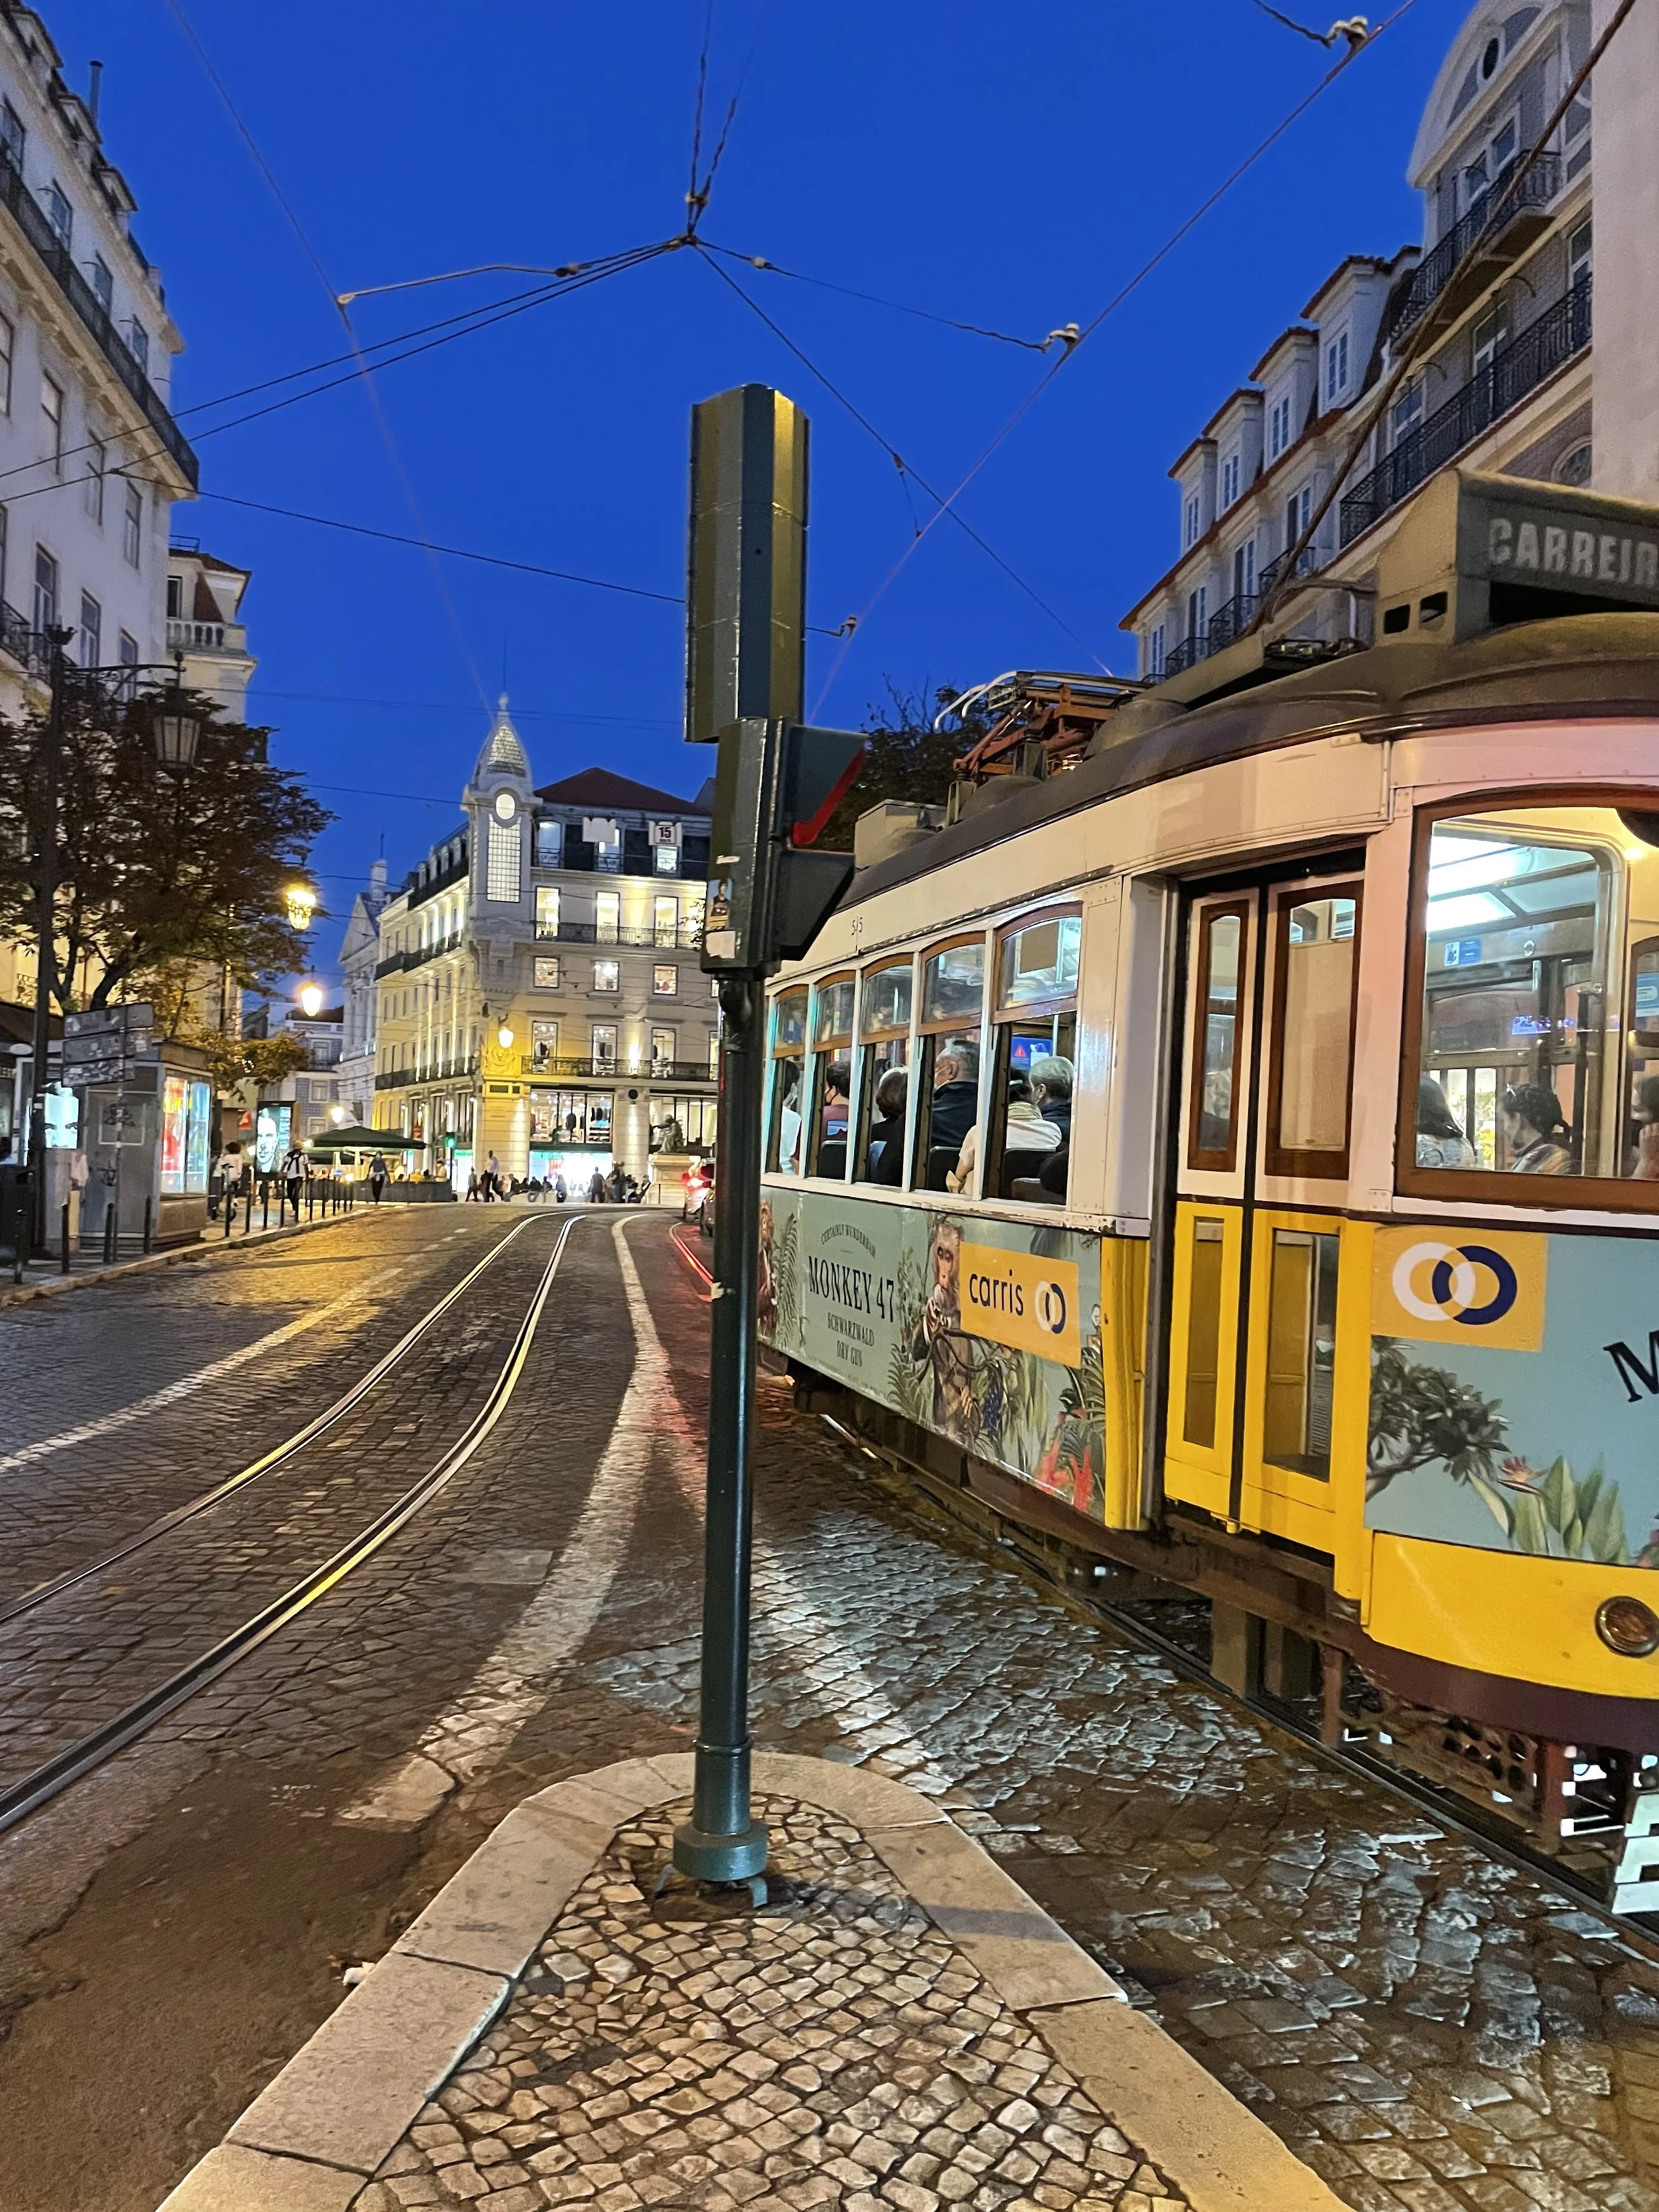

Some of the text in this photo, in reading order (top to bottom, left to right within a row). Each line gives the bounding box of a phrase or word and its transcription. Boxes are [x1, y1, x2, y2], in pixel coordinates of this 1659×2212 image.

[658, 826, 672, 838] 15
[808, 1256, 894, 1323] MONKEY 47
[970, 1269, 1024, 1316] carris
[828, 1312, 874, 1347] SCHWARZWALD
[837, 1340, 862, 1367] DRY GIN
